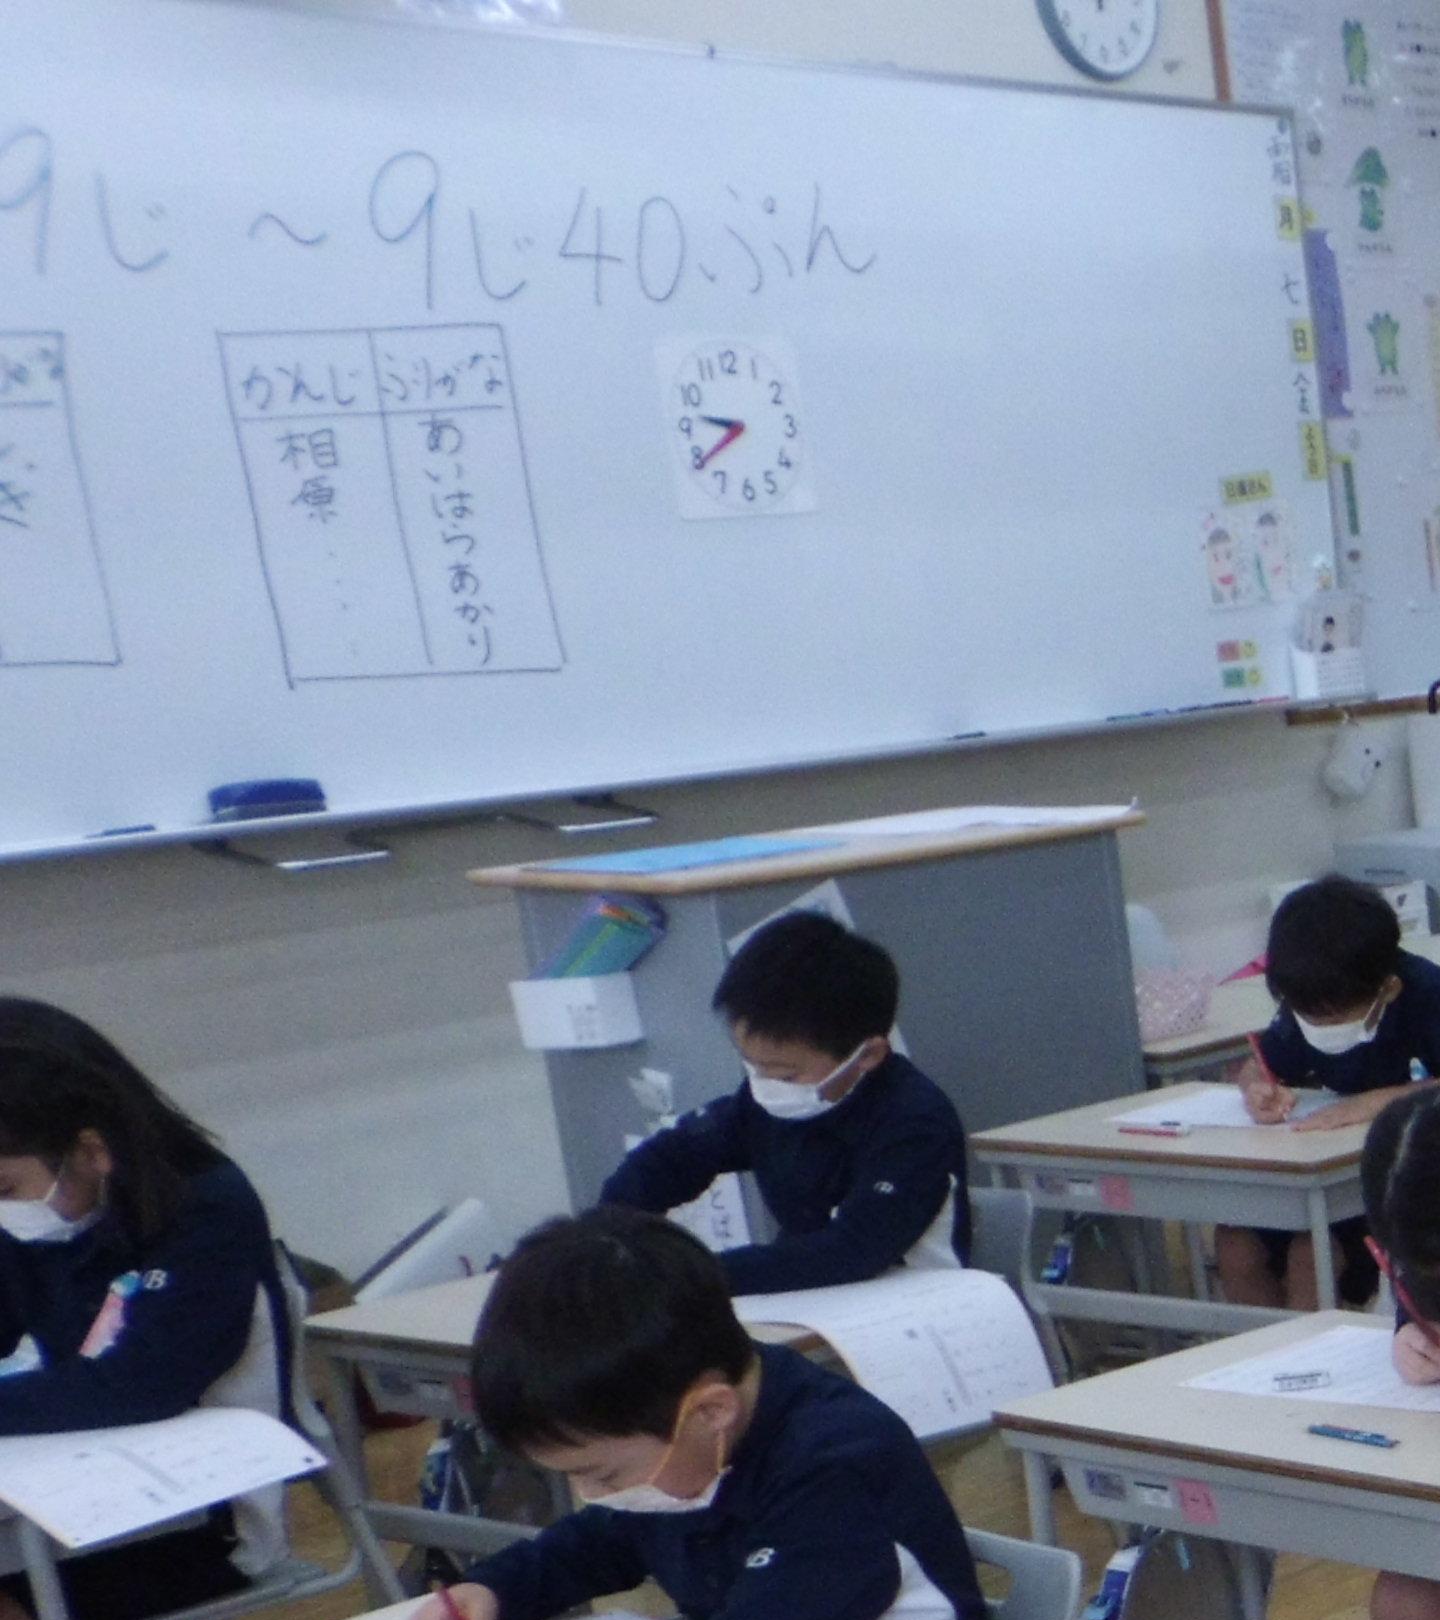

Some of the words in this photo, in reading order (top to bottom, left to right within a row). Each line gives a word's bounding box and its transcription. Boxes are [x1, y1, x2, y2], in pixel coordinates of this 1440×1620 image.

[698, 358, 714, 381] 11
[718, 349, 737, 375] 12
[751, 359, 757, 380] 1
[681, 382, 701, 407] 10
[769, 380, 782, 405] 2
[678, 416, 692, 440] 9
[784, 413, 797, 438] 3
[777, 446, 792, 470] 4
[713, 470, 727, 494] 7
[742, 478, 756, 502] 6
[763, 470, 778, 495] 5
[144, 1269, 168, 1290] B
